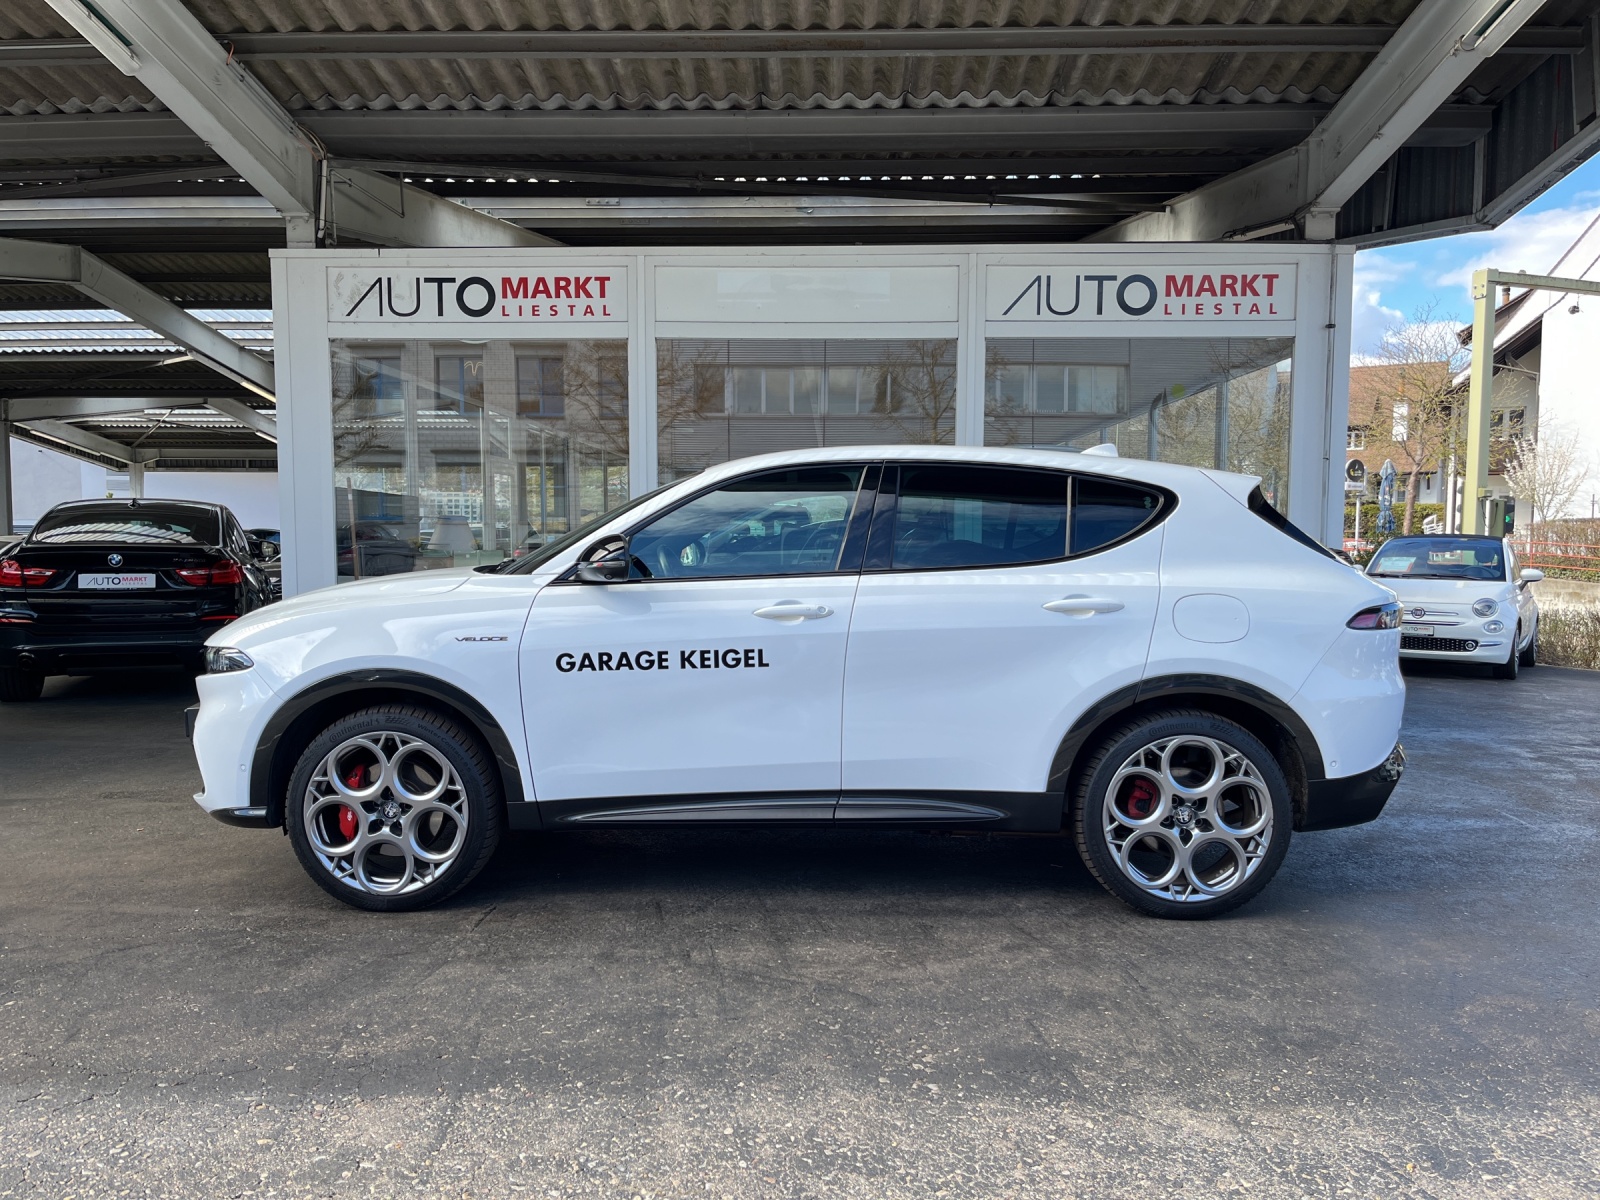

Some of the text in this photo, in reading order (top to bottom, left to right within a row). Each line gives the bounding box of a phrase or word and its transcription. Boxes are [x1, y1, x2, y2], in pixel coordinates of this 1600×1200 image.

[345, 276, 611, 318] AUTO MARKT
[1001, 274, 1280, 316] AUTO MARKT
[501, 304, 611, 317] LIESTAL
[1163, 303, 1278, 316] LIESTAL
[86, 576, 121, 586] AUTO
[555, 648, 770, 673] GARAGE KEIGEL
